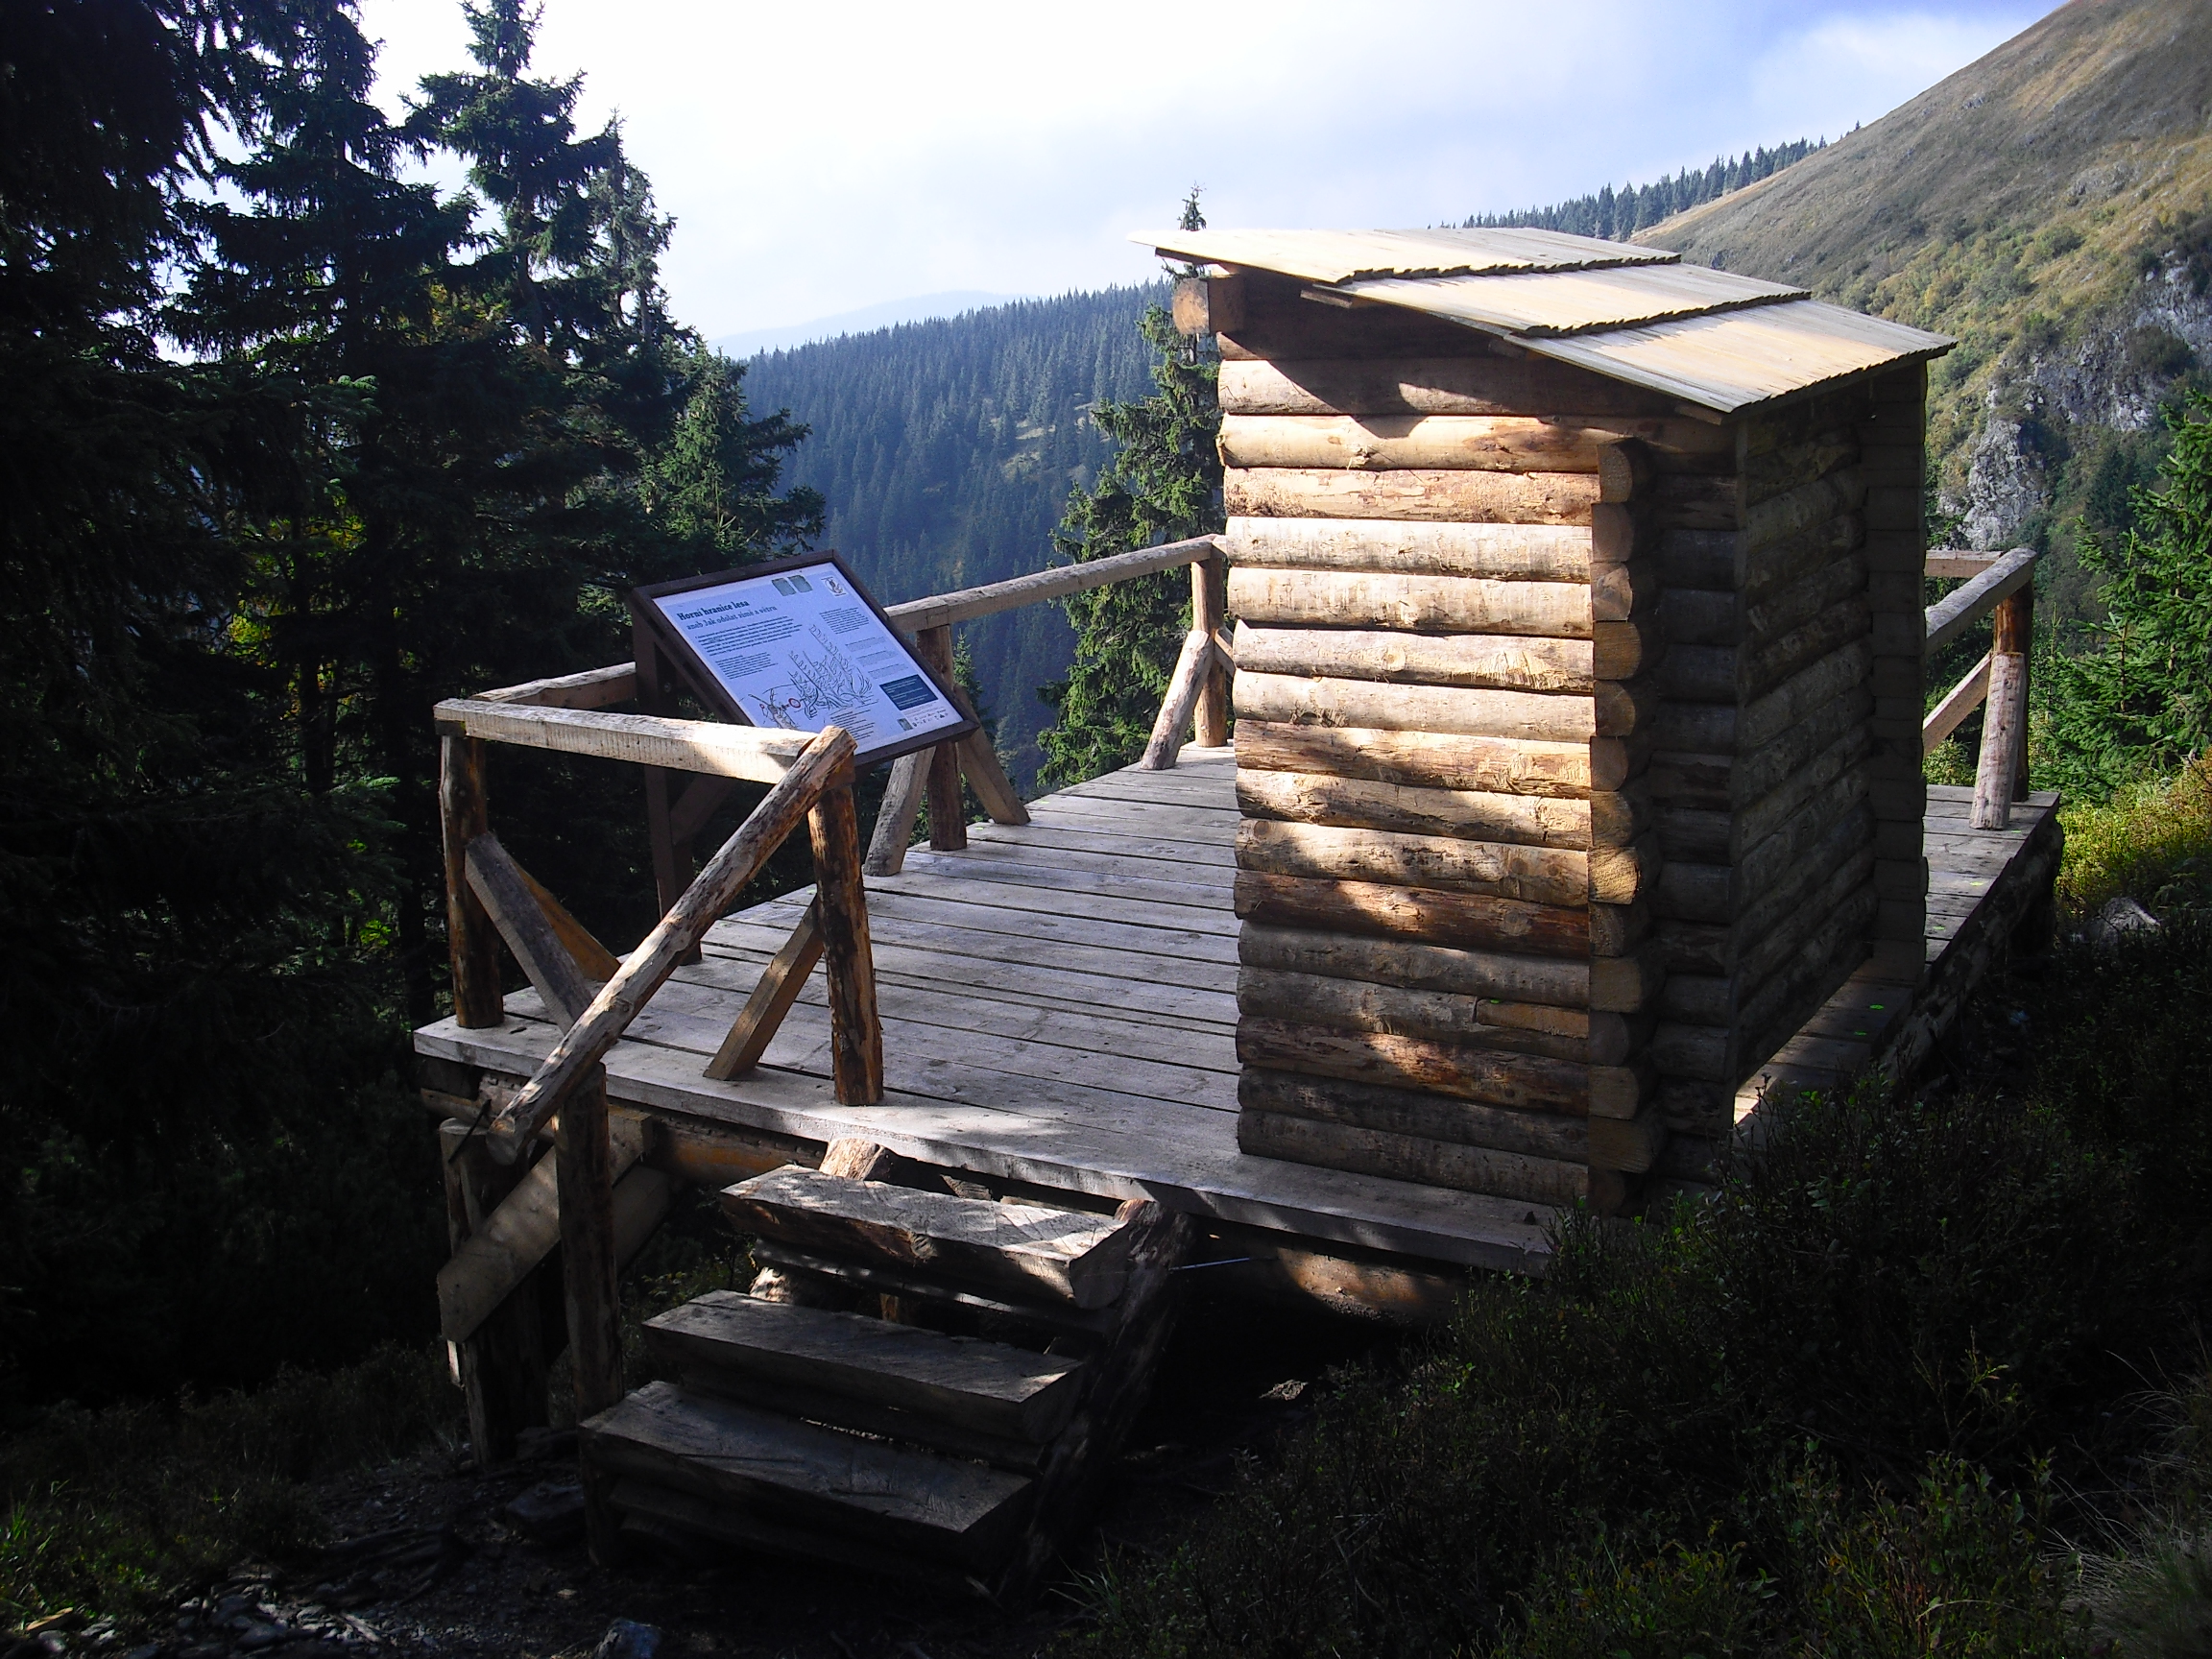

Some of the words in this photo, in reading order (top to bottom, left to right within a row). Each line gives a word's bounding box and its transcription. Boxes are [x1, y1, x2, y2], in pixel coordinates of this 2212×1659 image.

[701, 604, 732, 614] hranice
[732, 600, 750, 609] lesa
[705, 618, 716, 627] Jak
[717, 614, 737, 624] odolat
